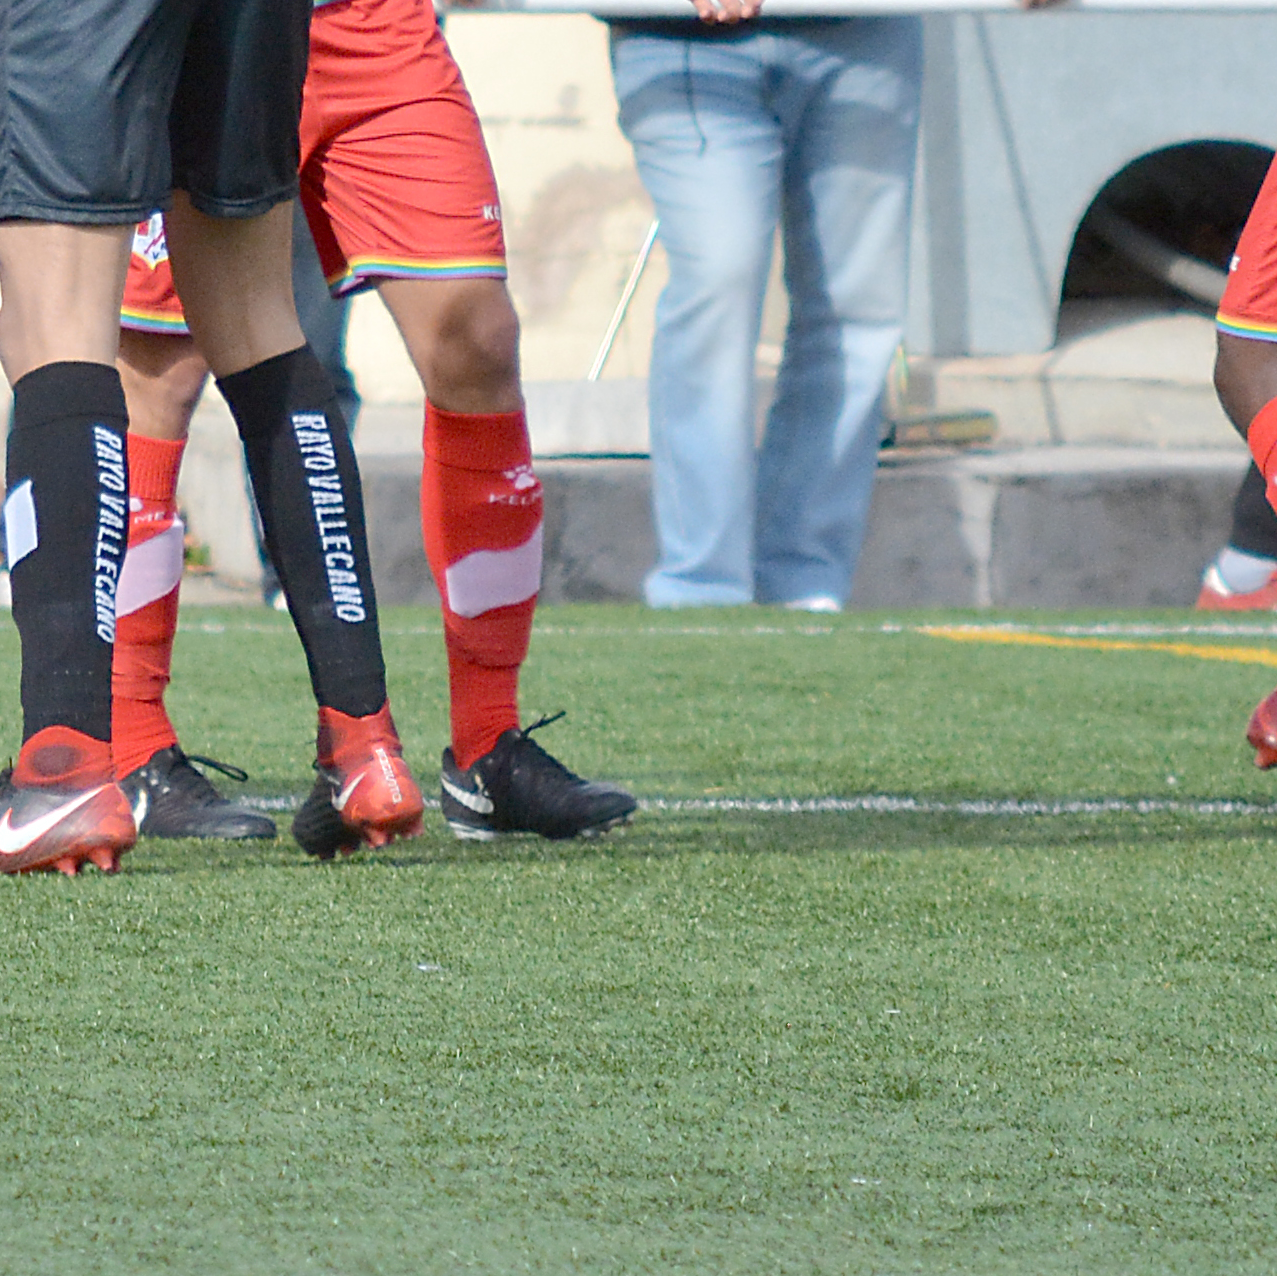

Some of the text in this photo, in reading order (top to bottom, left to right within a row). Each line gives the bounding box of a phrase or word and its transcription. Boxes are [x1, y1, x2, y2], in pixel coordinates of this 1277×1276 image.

[94, 425, 126, 645] RAYO VALLECANO
[291, 412, 367, 624] RAYO VALLECANO
